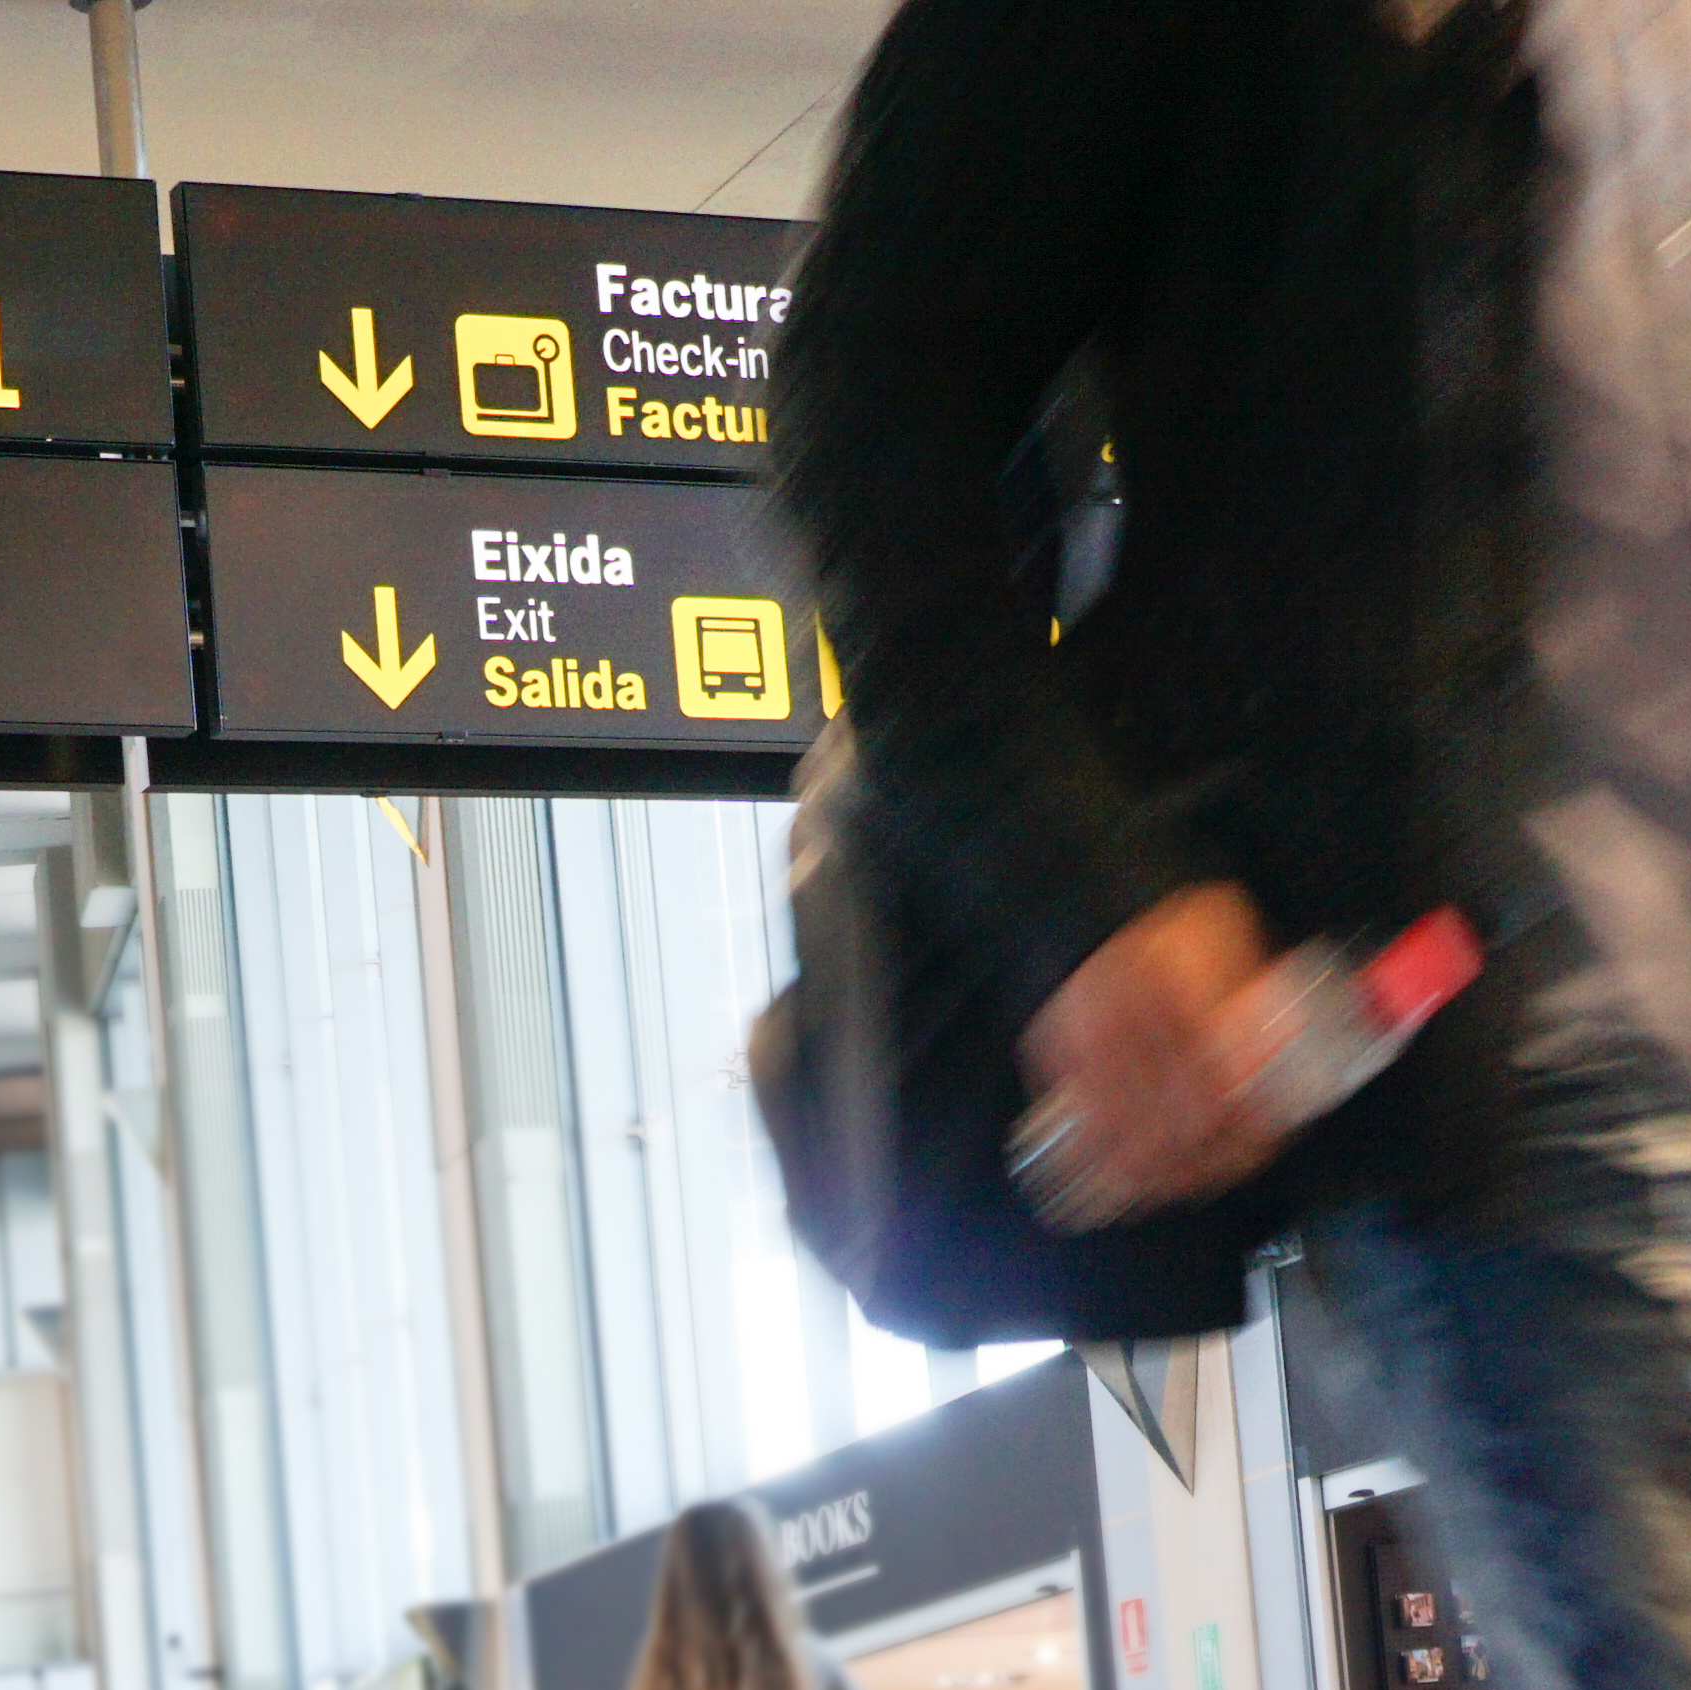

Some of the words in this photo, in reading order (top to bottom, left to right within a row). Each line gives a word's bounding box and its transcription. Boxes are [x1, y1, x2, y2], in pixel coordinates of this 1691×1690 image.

[595, 262, 793, 324] Factura
[602, 327, 769, 380] Check-in
[606, 386, 768, 443] Factur
[470, 528, 635, 588] Eixida
[476, 595, 557, 644] Exit
[482, 654, 647, 712] Salida
